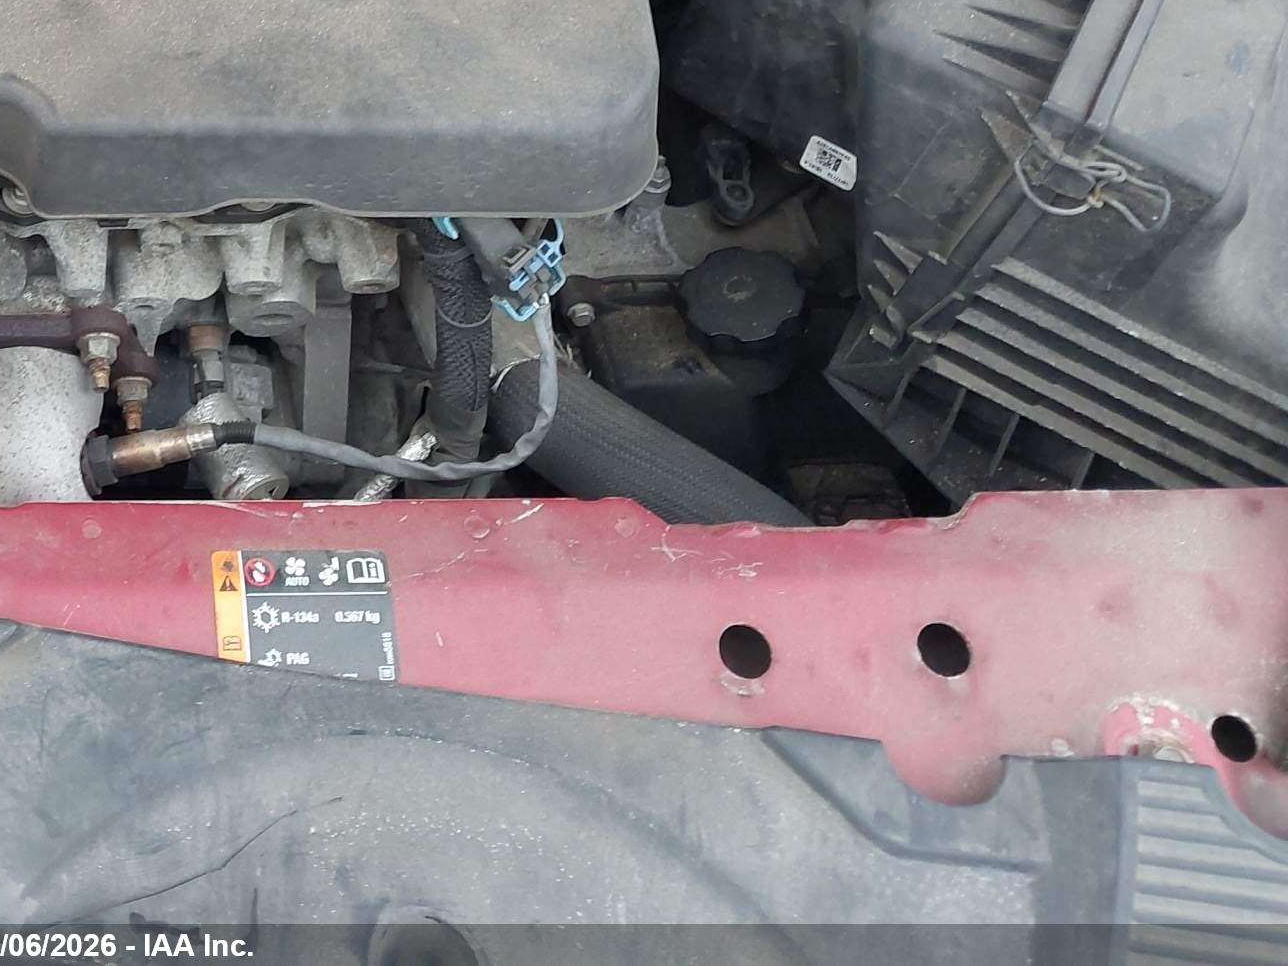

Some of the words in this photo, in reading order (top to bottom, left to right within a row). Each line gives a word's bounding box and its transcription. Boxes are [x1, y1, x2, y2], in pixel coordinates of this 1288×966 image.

[284, 575, 311, 587] AUTO
[281, 611, 320, 623] R-134a
[365, 610, 381, 624] kg
[286, 652, 310, 665] PAG
